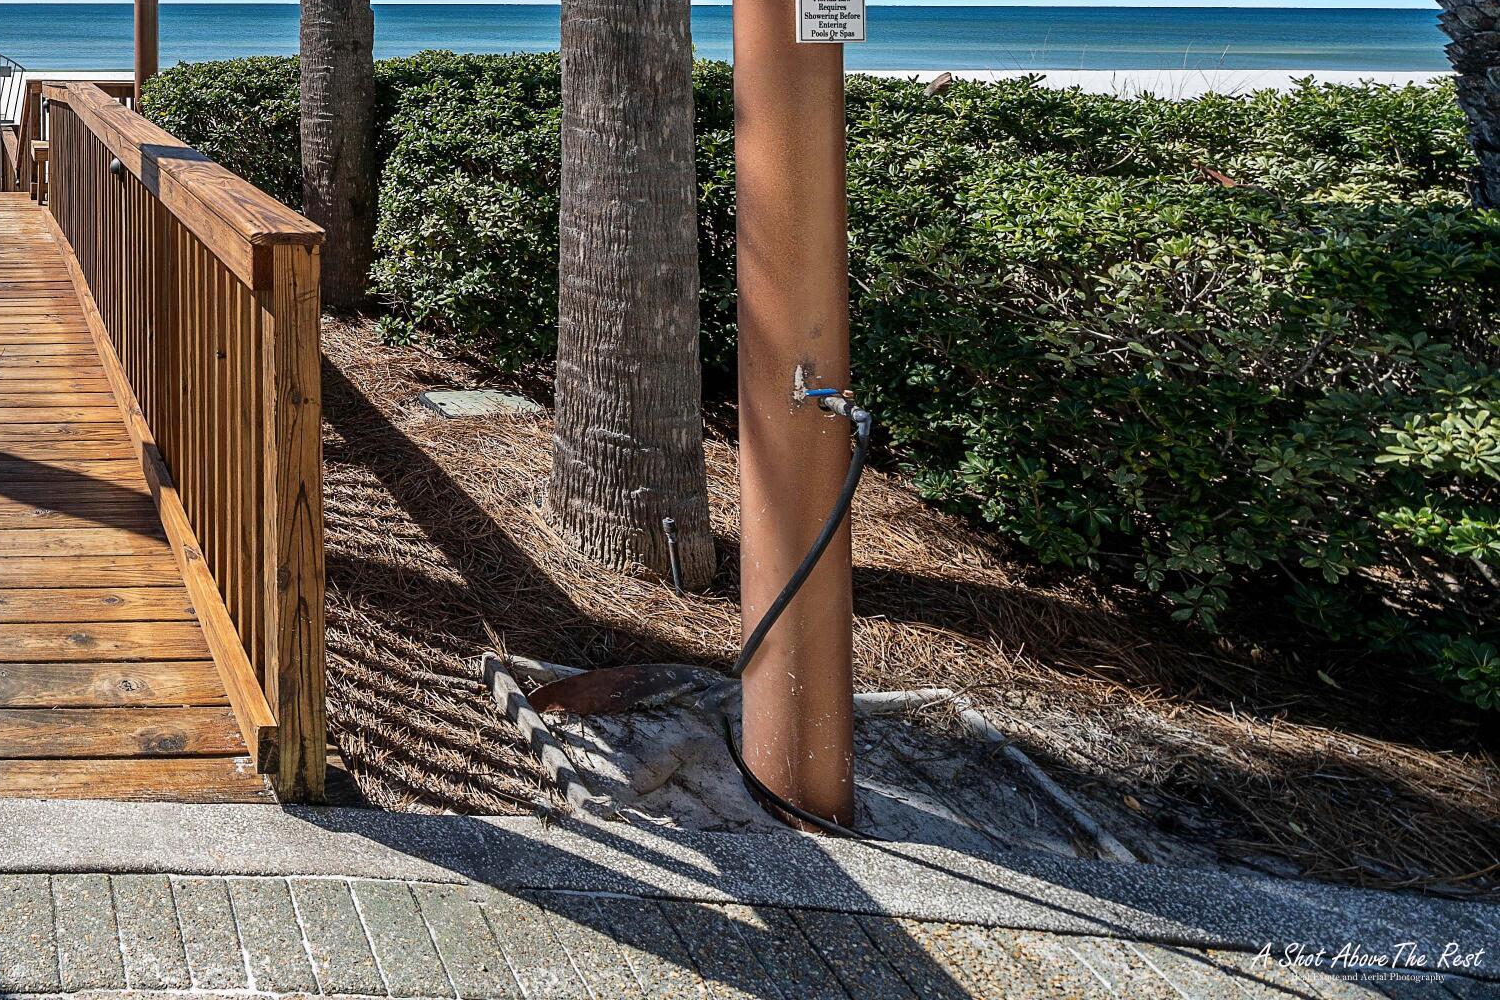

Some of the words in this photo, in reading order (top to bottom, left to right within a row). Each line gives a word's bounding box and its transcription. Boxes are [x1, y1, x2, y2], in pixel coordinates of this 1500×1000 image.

[818, 4, 847, 12] Requires
[804, 12, 839, 21] Showering
[818, 20, 847, 30] Entering
[840, 30, 855, 38] Spas
